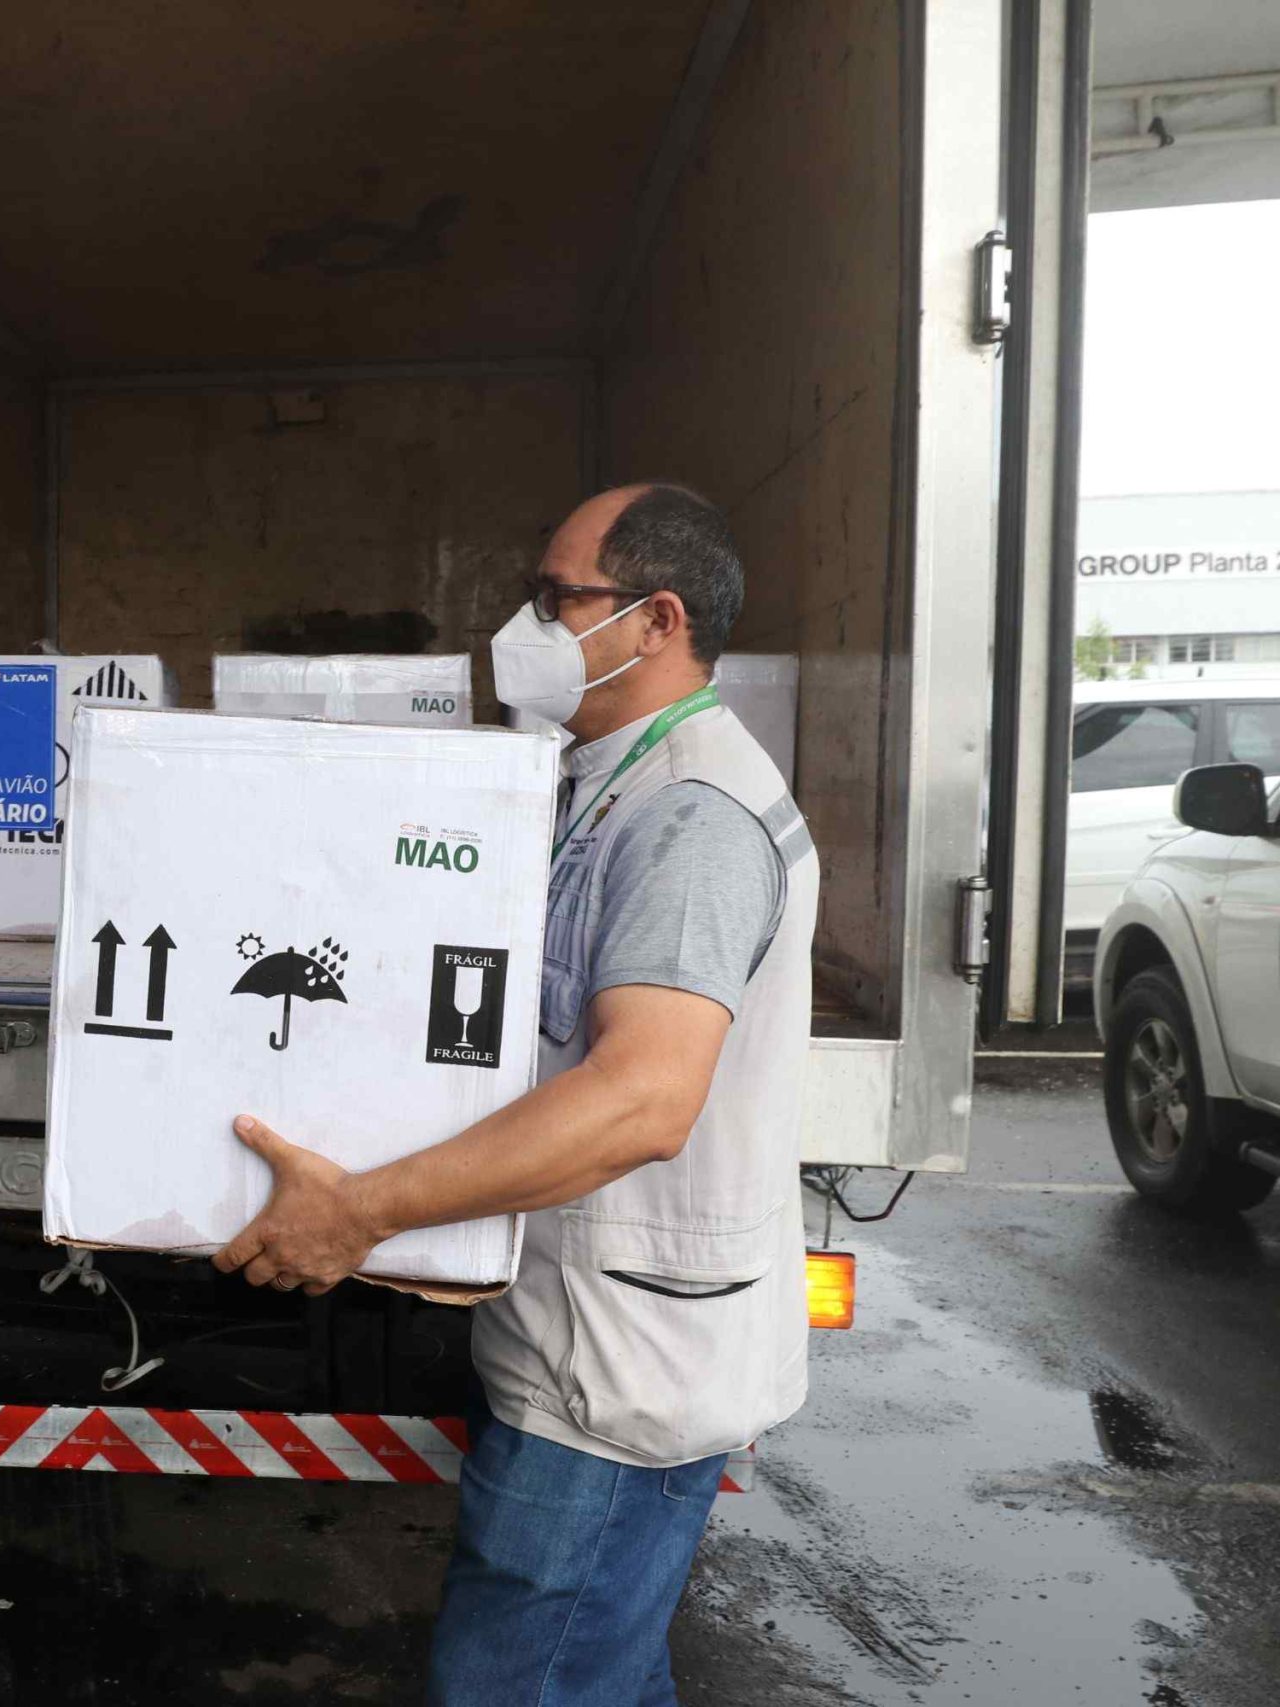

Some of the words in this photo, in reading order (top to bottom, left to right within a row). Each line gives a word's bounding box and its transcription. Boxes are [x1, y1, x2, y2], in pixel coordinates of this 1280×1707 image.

[1078, 553, 1181, 576] GROUP
[1190, 551, 1268, 572] Planta
[3, 674, 48, 683] LATAM
[411, 698, 455, 714] MAO
[395, 837, 479, 873] MAO
[445, 952, 496, 968] FRÁGIL
[433, 1048, 494, 1062] FRAGILE
